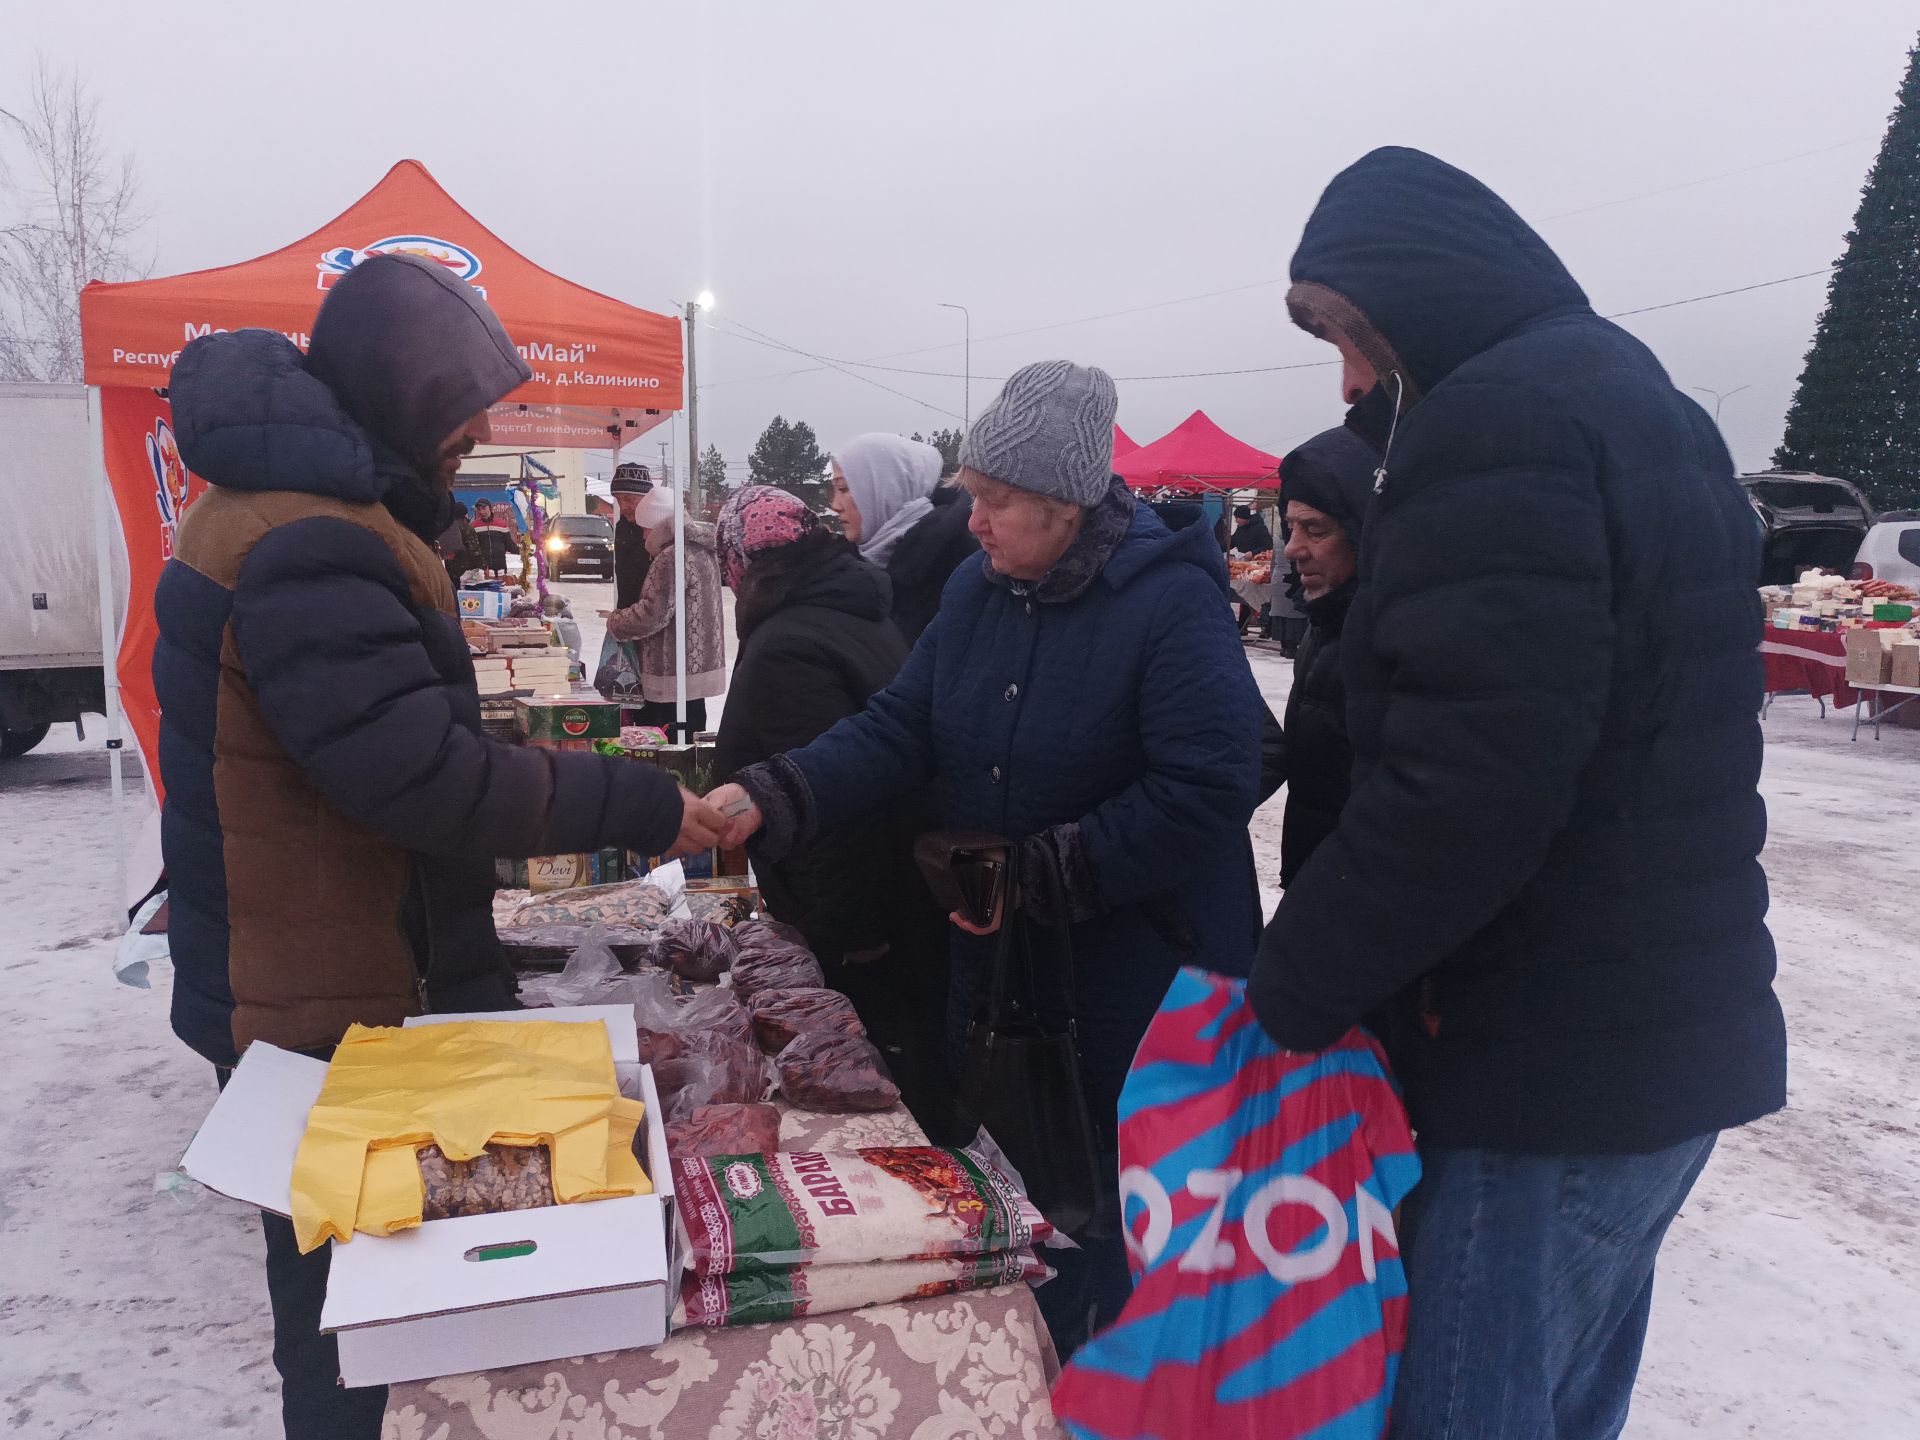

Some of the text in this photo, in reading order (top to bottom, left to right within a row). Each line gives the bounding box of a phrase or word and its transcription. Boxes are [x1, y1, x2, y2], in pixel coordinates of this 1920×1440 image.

[113, 348, 182, 369] Респуб
[516, 342, 596, 363] лМай"
[555, 371, 660, 388] д.Калинино
[537, 859, 576, 876] Devi
